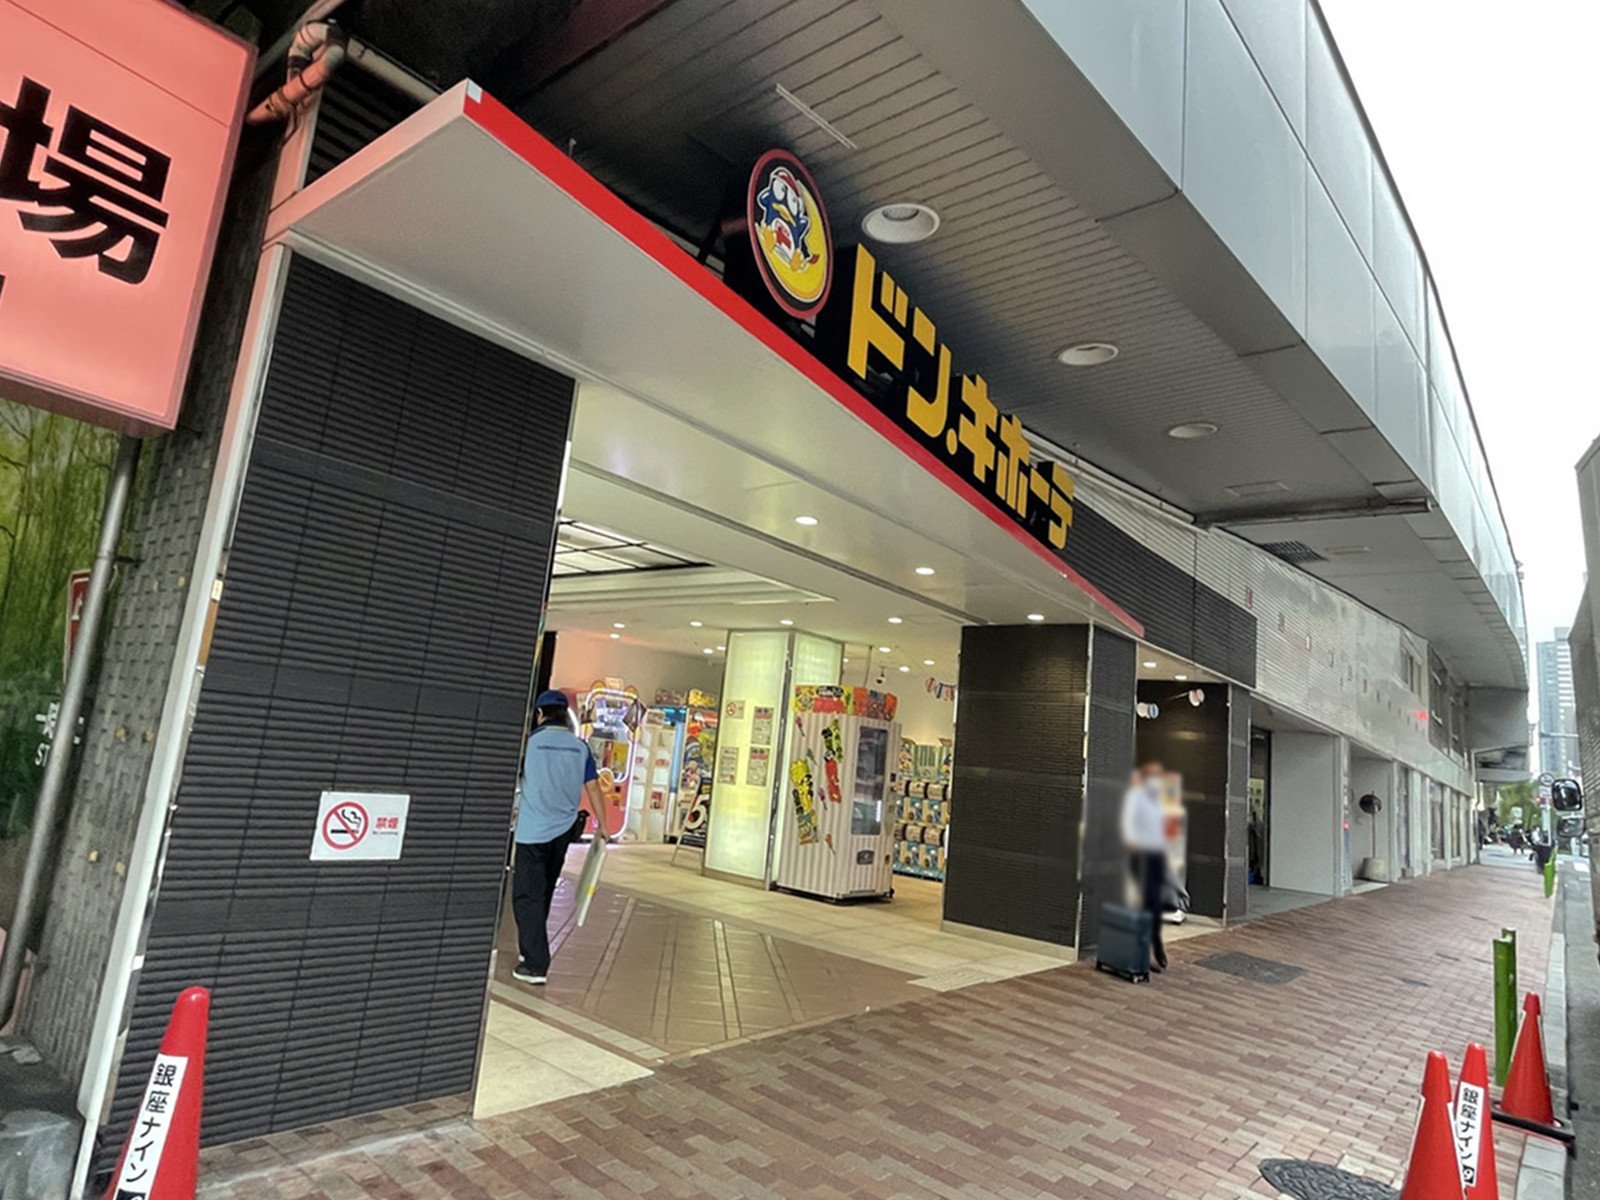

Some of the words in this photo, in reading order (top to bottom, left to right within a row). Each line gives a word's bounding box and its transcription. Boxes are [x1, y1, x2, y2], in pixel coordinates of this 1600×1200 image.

[0, 75, 171, 285] 場
[126, 1063, 177, 1183] 銀座ナイン
[1459, 1087, 1478, 1160] 銀座ナイン
